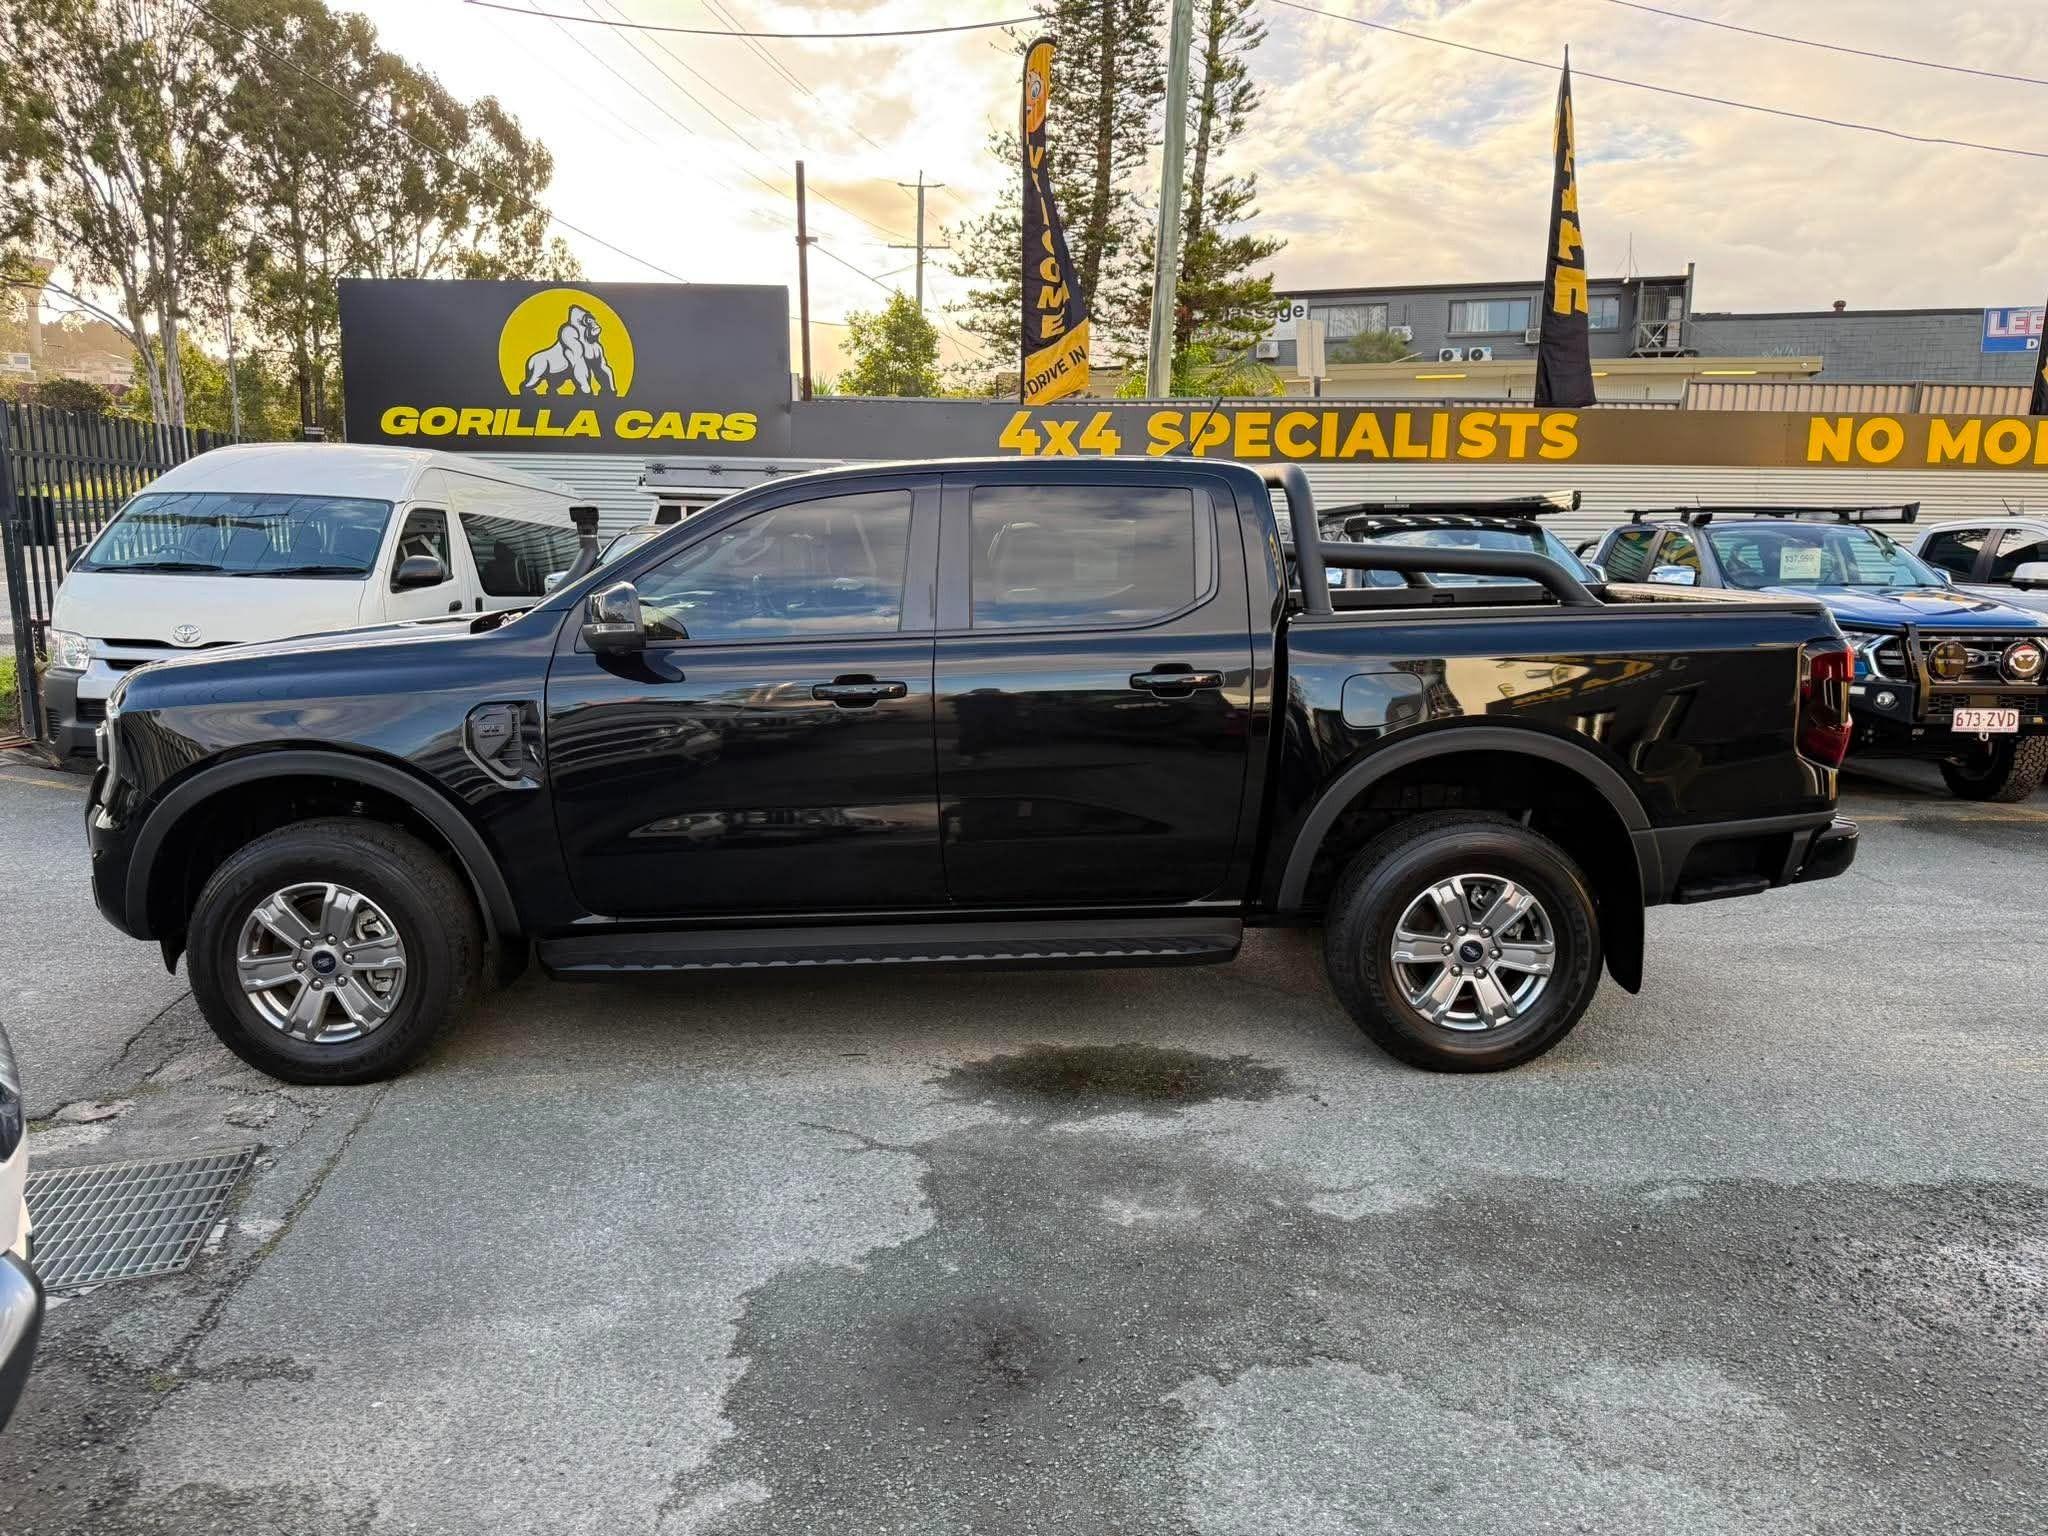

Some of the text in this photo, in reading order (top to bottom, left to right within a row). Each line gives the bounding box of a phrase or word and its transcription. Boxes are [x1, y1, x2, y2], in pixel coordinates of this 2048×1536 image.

[1026, 345, 1087, 396] DRIVE IN
[380, 406, 758, 442] GORILLA CARS
[998, 410, 1579, 460] 4x4 SPECIALISTS
[1807, 416, 1905, 464] NO
[1956, 710, 2017, 728] 673 ZVD
